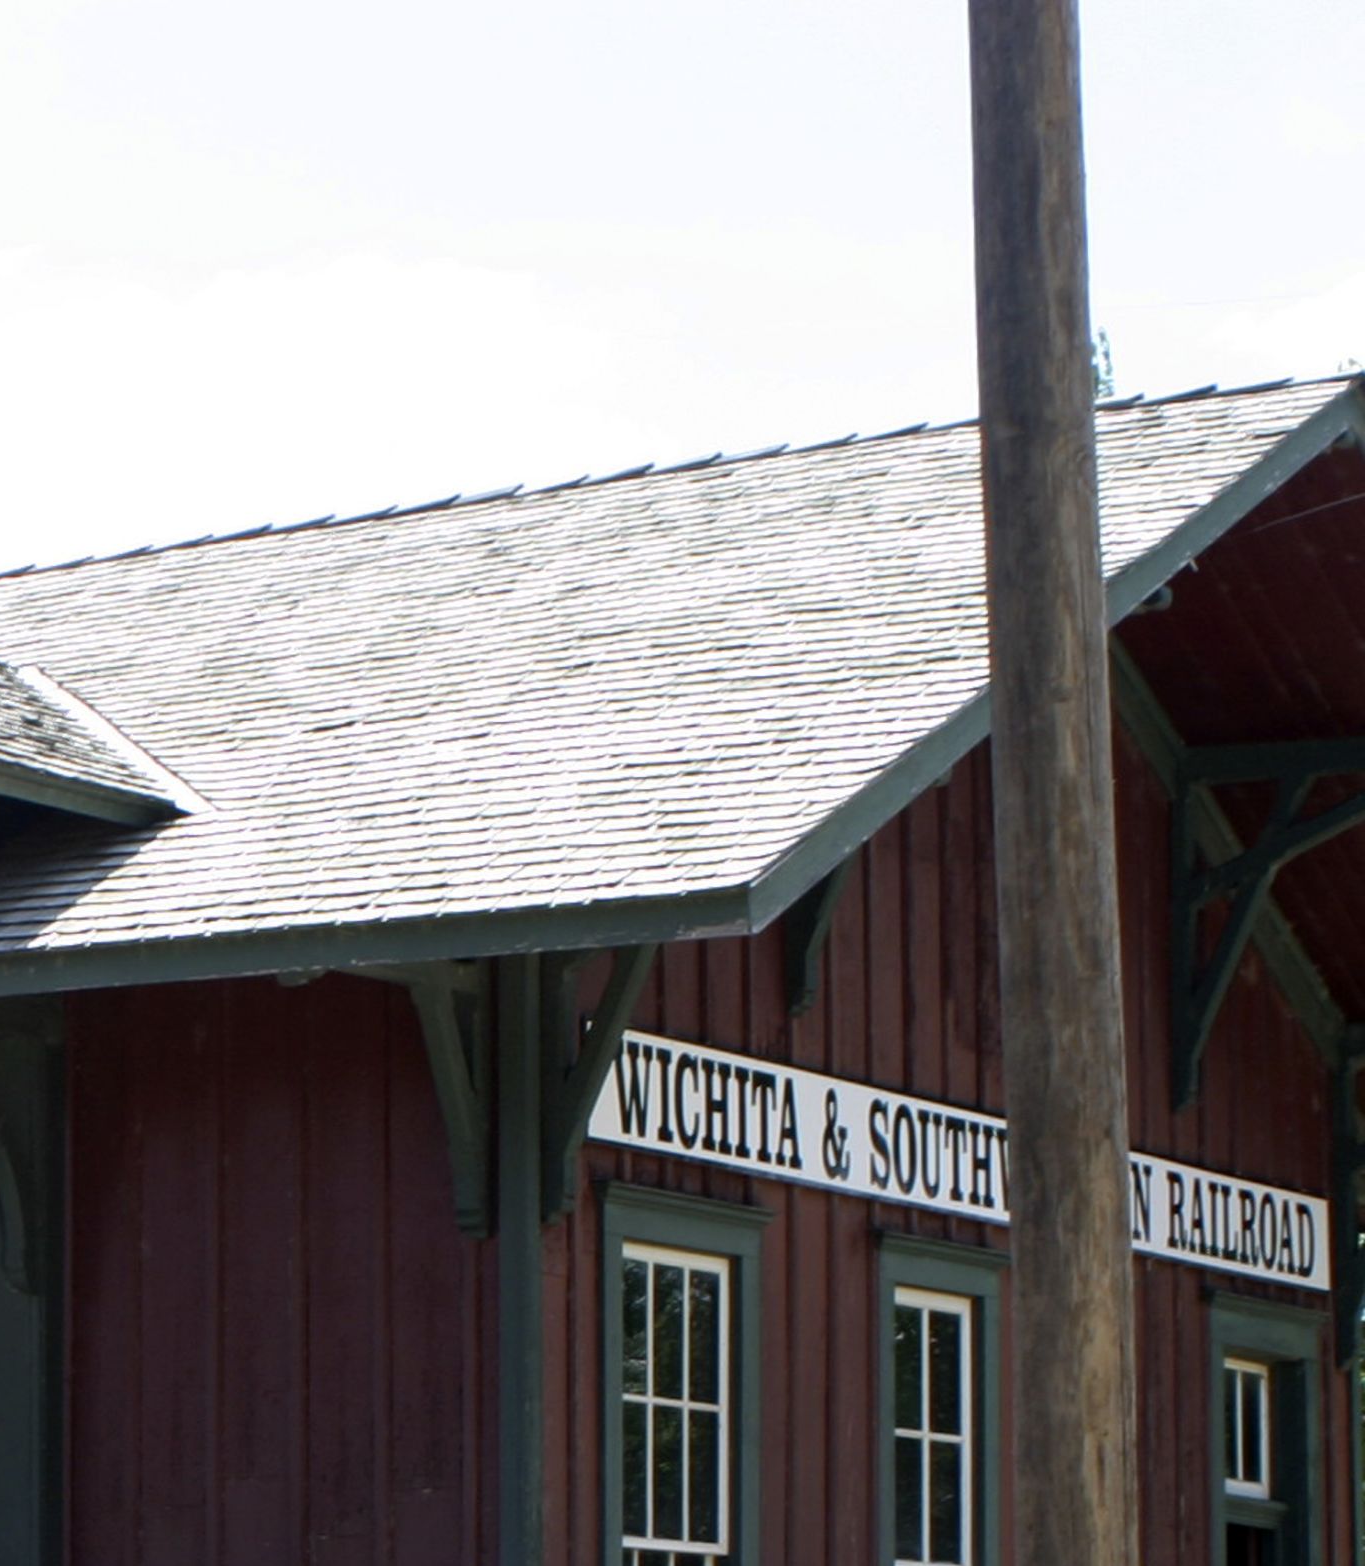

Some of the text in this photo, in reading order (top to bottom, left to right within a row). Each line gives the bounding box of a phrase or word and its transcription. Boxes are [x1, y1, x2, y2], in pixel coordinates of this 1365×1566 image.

[615, 1041, 802, 1169] WICHITA
[822, 1088, 851, 1181] &
[1167, 1171, 1315, 1277] RAILROAD
